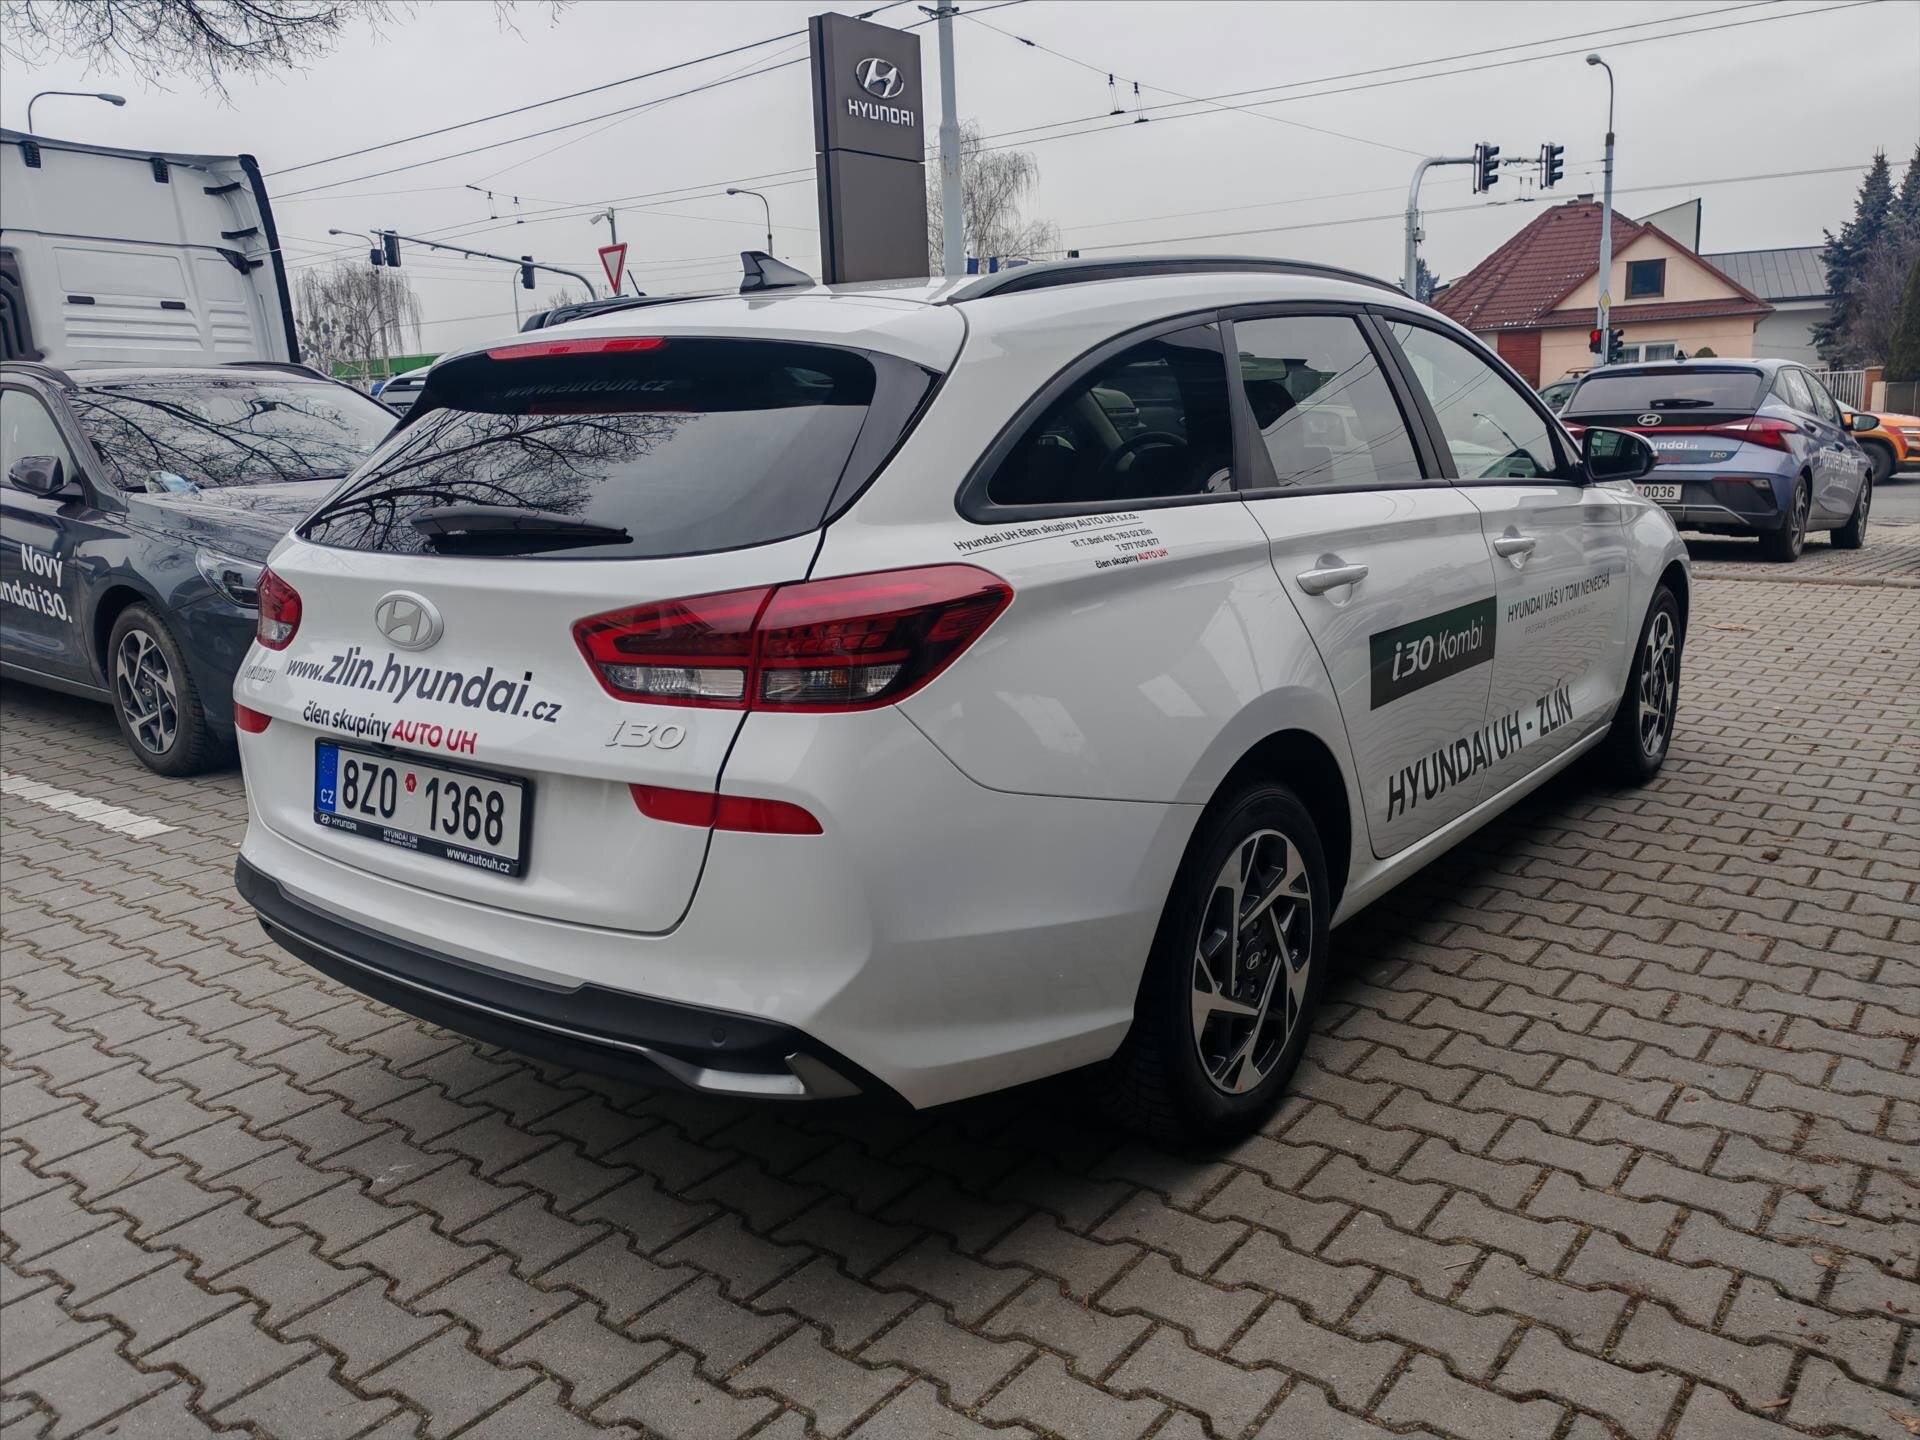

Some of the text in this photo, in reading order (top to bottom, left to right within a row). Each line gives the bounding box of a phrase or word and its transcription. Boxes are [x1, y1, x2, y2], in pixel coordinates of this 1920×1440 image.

[848, 98, 914, 127] HYUNDAI
[1643, 486, 1675, 498] 0036
[954, 534, 1001, 551] Hyundai
[1002, 531, 1018, 542] UH
[1019, 527, 1040, 538] člen
[1041, 521, 1078, 535] skupiny
[1078, 517, 1103, 528] AUTO
[1103, 514, 1117, 524] UH
[21, 543, 62, 588] Nový
[1138, 551, 1157, 560] AUTO
[1157, 549, 1168, 557] UH
[38, 585, 73, 624] i30.
[1507, 594, 1543, 623] HYUNDAI
[1545, 586, 1558, 608] VÁS
[1566, 582, 1580, 602] TOM
[1581, 568, 1610, 596] NENECHÁ
[1392, 616, 1485, 681] i30 Kombi
[286, 646, 562, 723] www.zlin.hyundai.cz
[303, 700, 478, 754] člen skupiny AUTO UH
[1386, 729, 1493, 823] HYUNDAI
[1493, 710, 1523, 760] UH
[1536, 678, 1574, 737] ZLÍN
[320, 788, 334, 804] CZ
[342, 759, 504, 846] 8Z0 1368
[331, 817, 357, 831] HYUNDAI
[383, 828, 409, 842] HYUNDAI
[446, 847, 510, 873] www.autouh.cz
